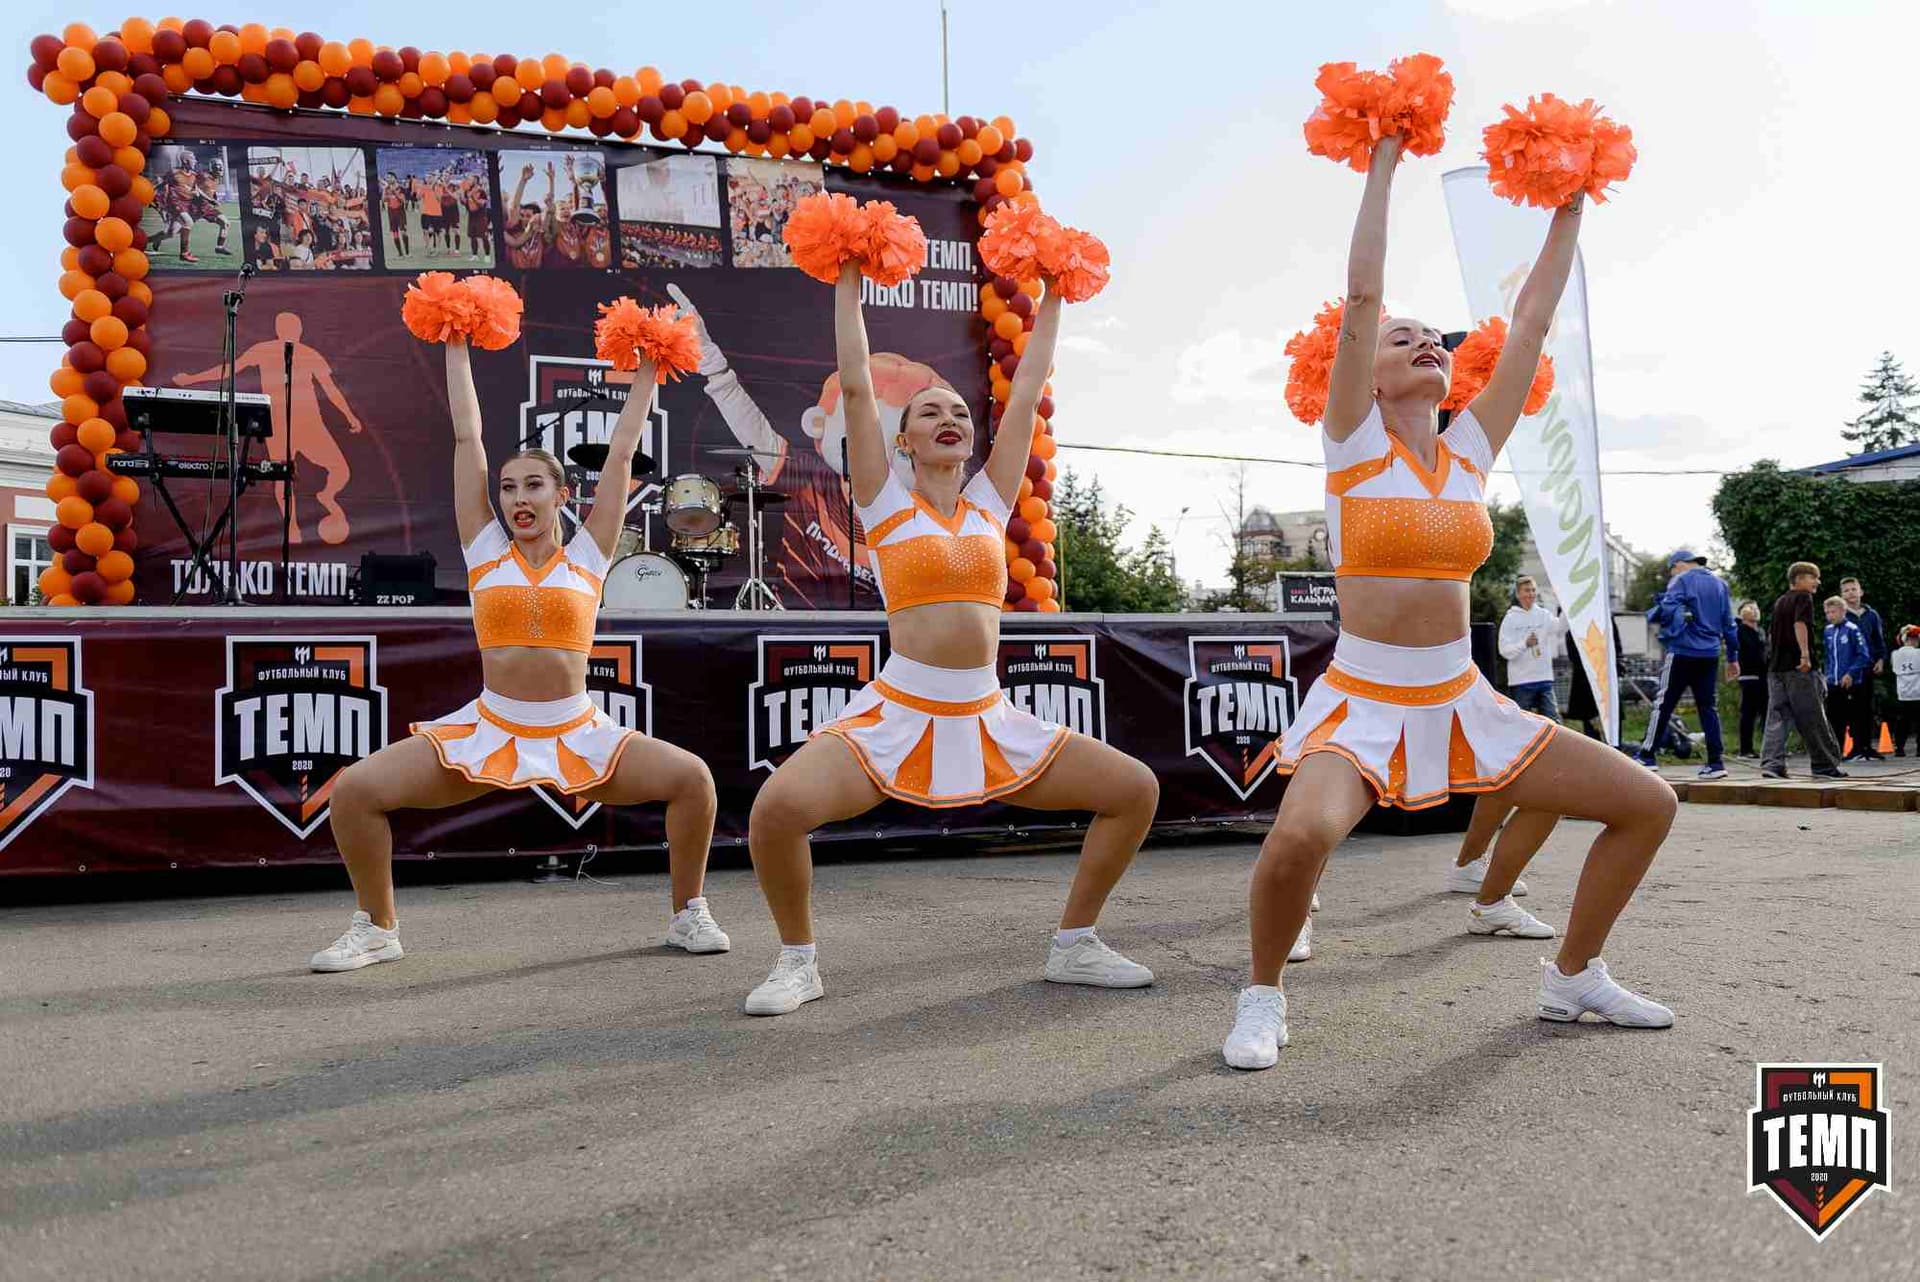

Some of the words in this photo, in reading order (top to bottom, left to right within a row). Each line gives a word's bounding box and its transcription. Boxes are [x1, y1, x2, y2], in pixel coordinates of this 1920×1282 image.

[859, 274, 915, 308] ЛЬКО
[920, 279, 978, 311] ТЕМП!
[612, 389, 631, 402] КЛУ
[178, 460, 210, 470] electro
[391, 594, 415, 604] POP
[258, 666, 320, 681] ФУТБОЛЬНЫЙ
[322, 668, 347, 681] КЛУБ
[593, 665, 616, 678] КЛУБ
[784, 662, 833, 677] ФУТБОЛЬНЫЙ
[836, 665, 856, 676] КЛУБ
[1007, 661, 1053, 674] ФУТБОЛЬНЫЙ
[1055, 663, 1074, 674] КЛУБ
[21, 670, 48, 683] КЛУБ
[1000, 683, 1093, 738] ЕМП
[1196, 682, 1289, 737] ТЕМП
[763, 686, 860, 748] ТЕМ
[233, 692, 371, 762] ТЕМП
[292, 759, 313, 771] 2020
